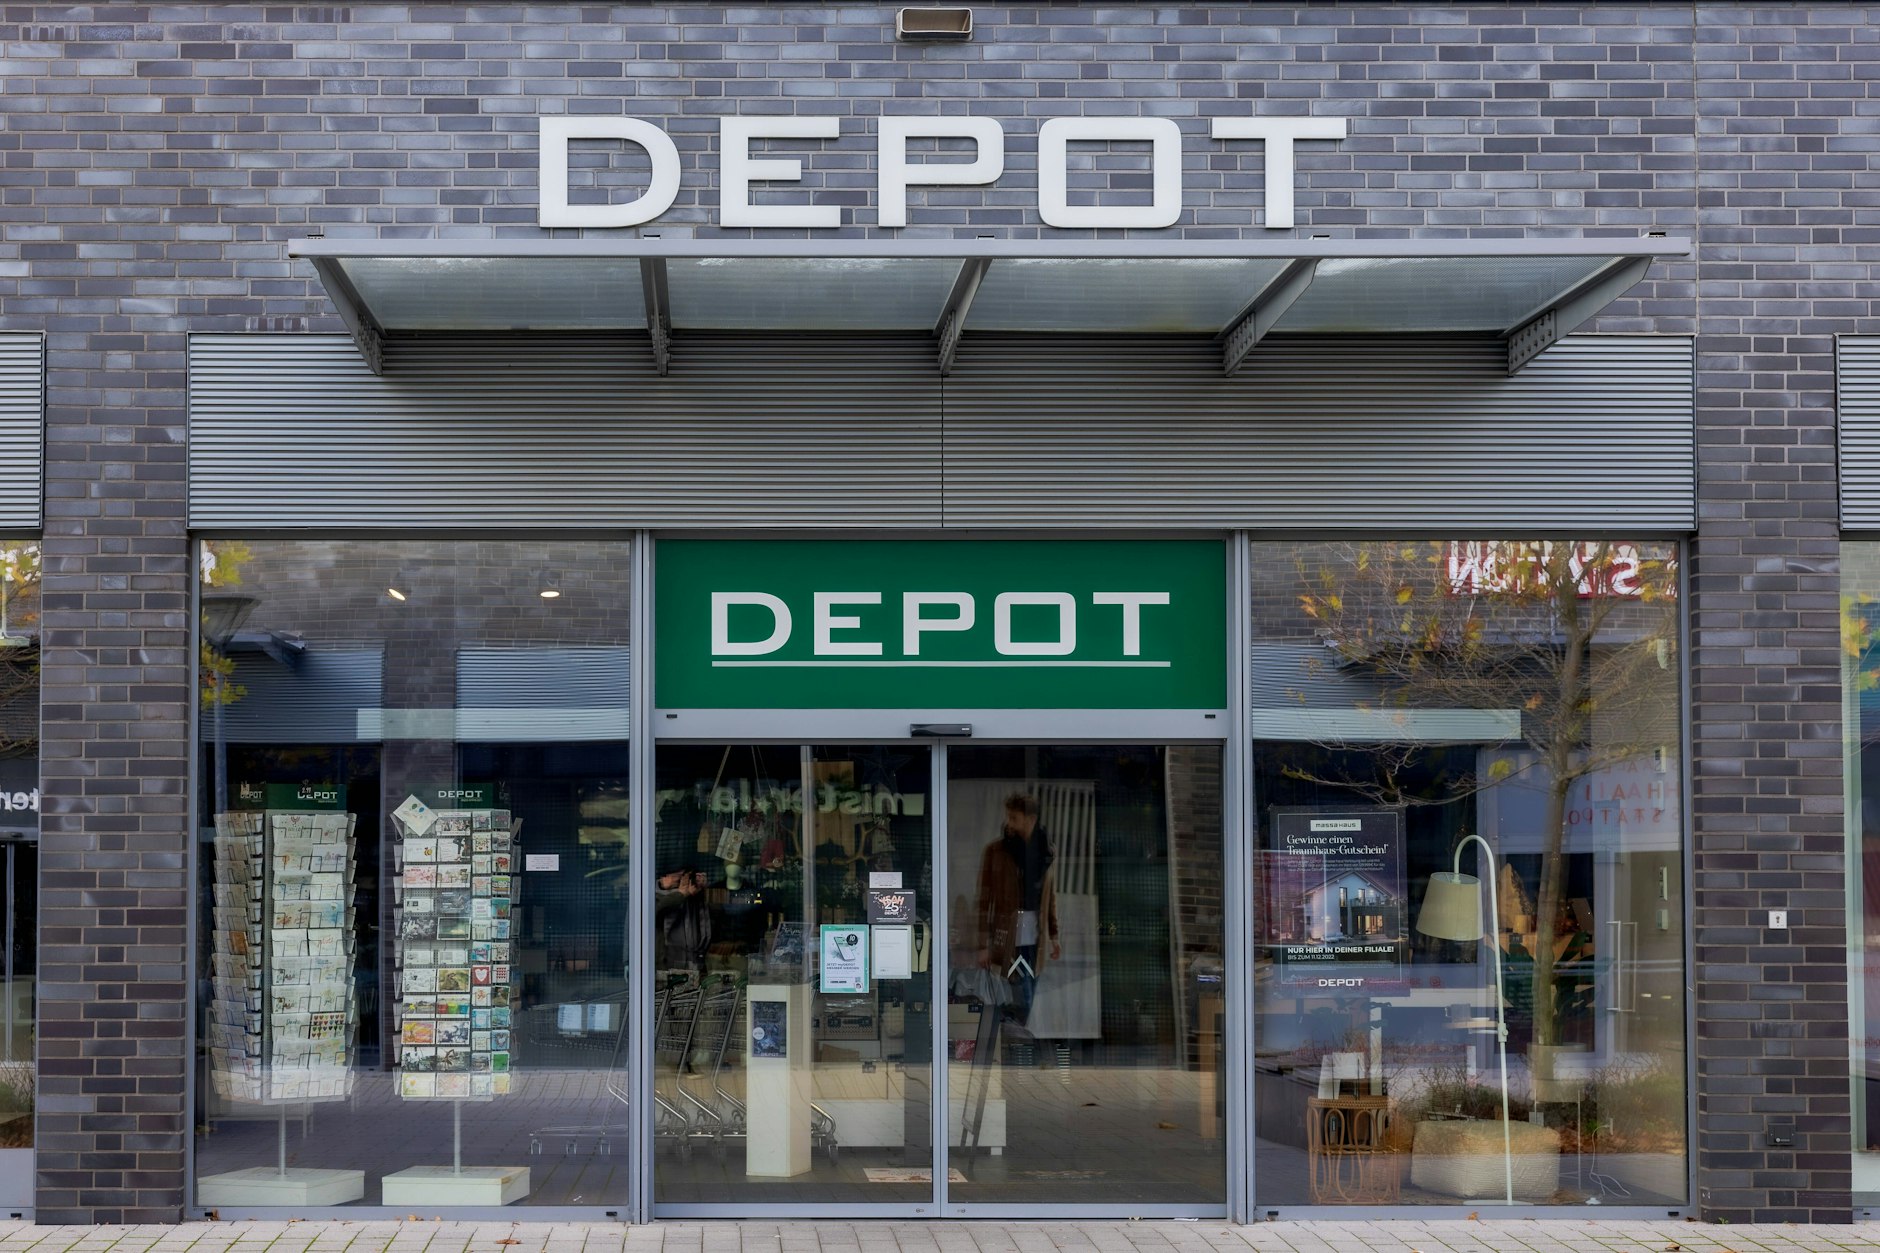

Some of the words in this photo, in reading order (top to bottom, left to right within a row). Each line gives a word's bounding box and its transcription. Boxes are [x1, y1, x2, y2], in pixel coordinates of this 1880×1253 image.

[540, 116, 1348, 229] DEPOT
[711, 592, 1170, 656] DEPOT
[438, 790, 483, 798] DEPOT
[1286, 834, 1328, 845] Gewinne
[1328, 835, 1354, 845] einen
[1364, 945, 1395, 953] FILIALE!
[1318, 978, 1364, 987] DEPOT
